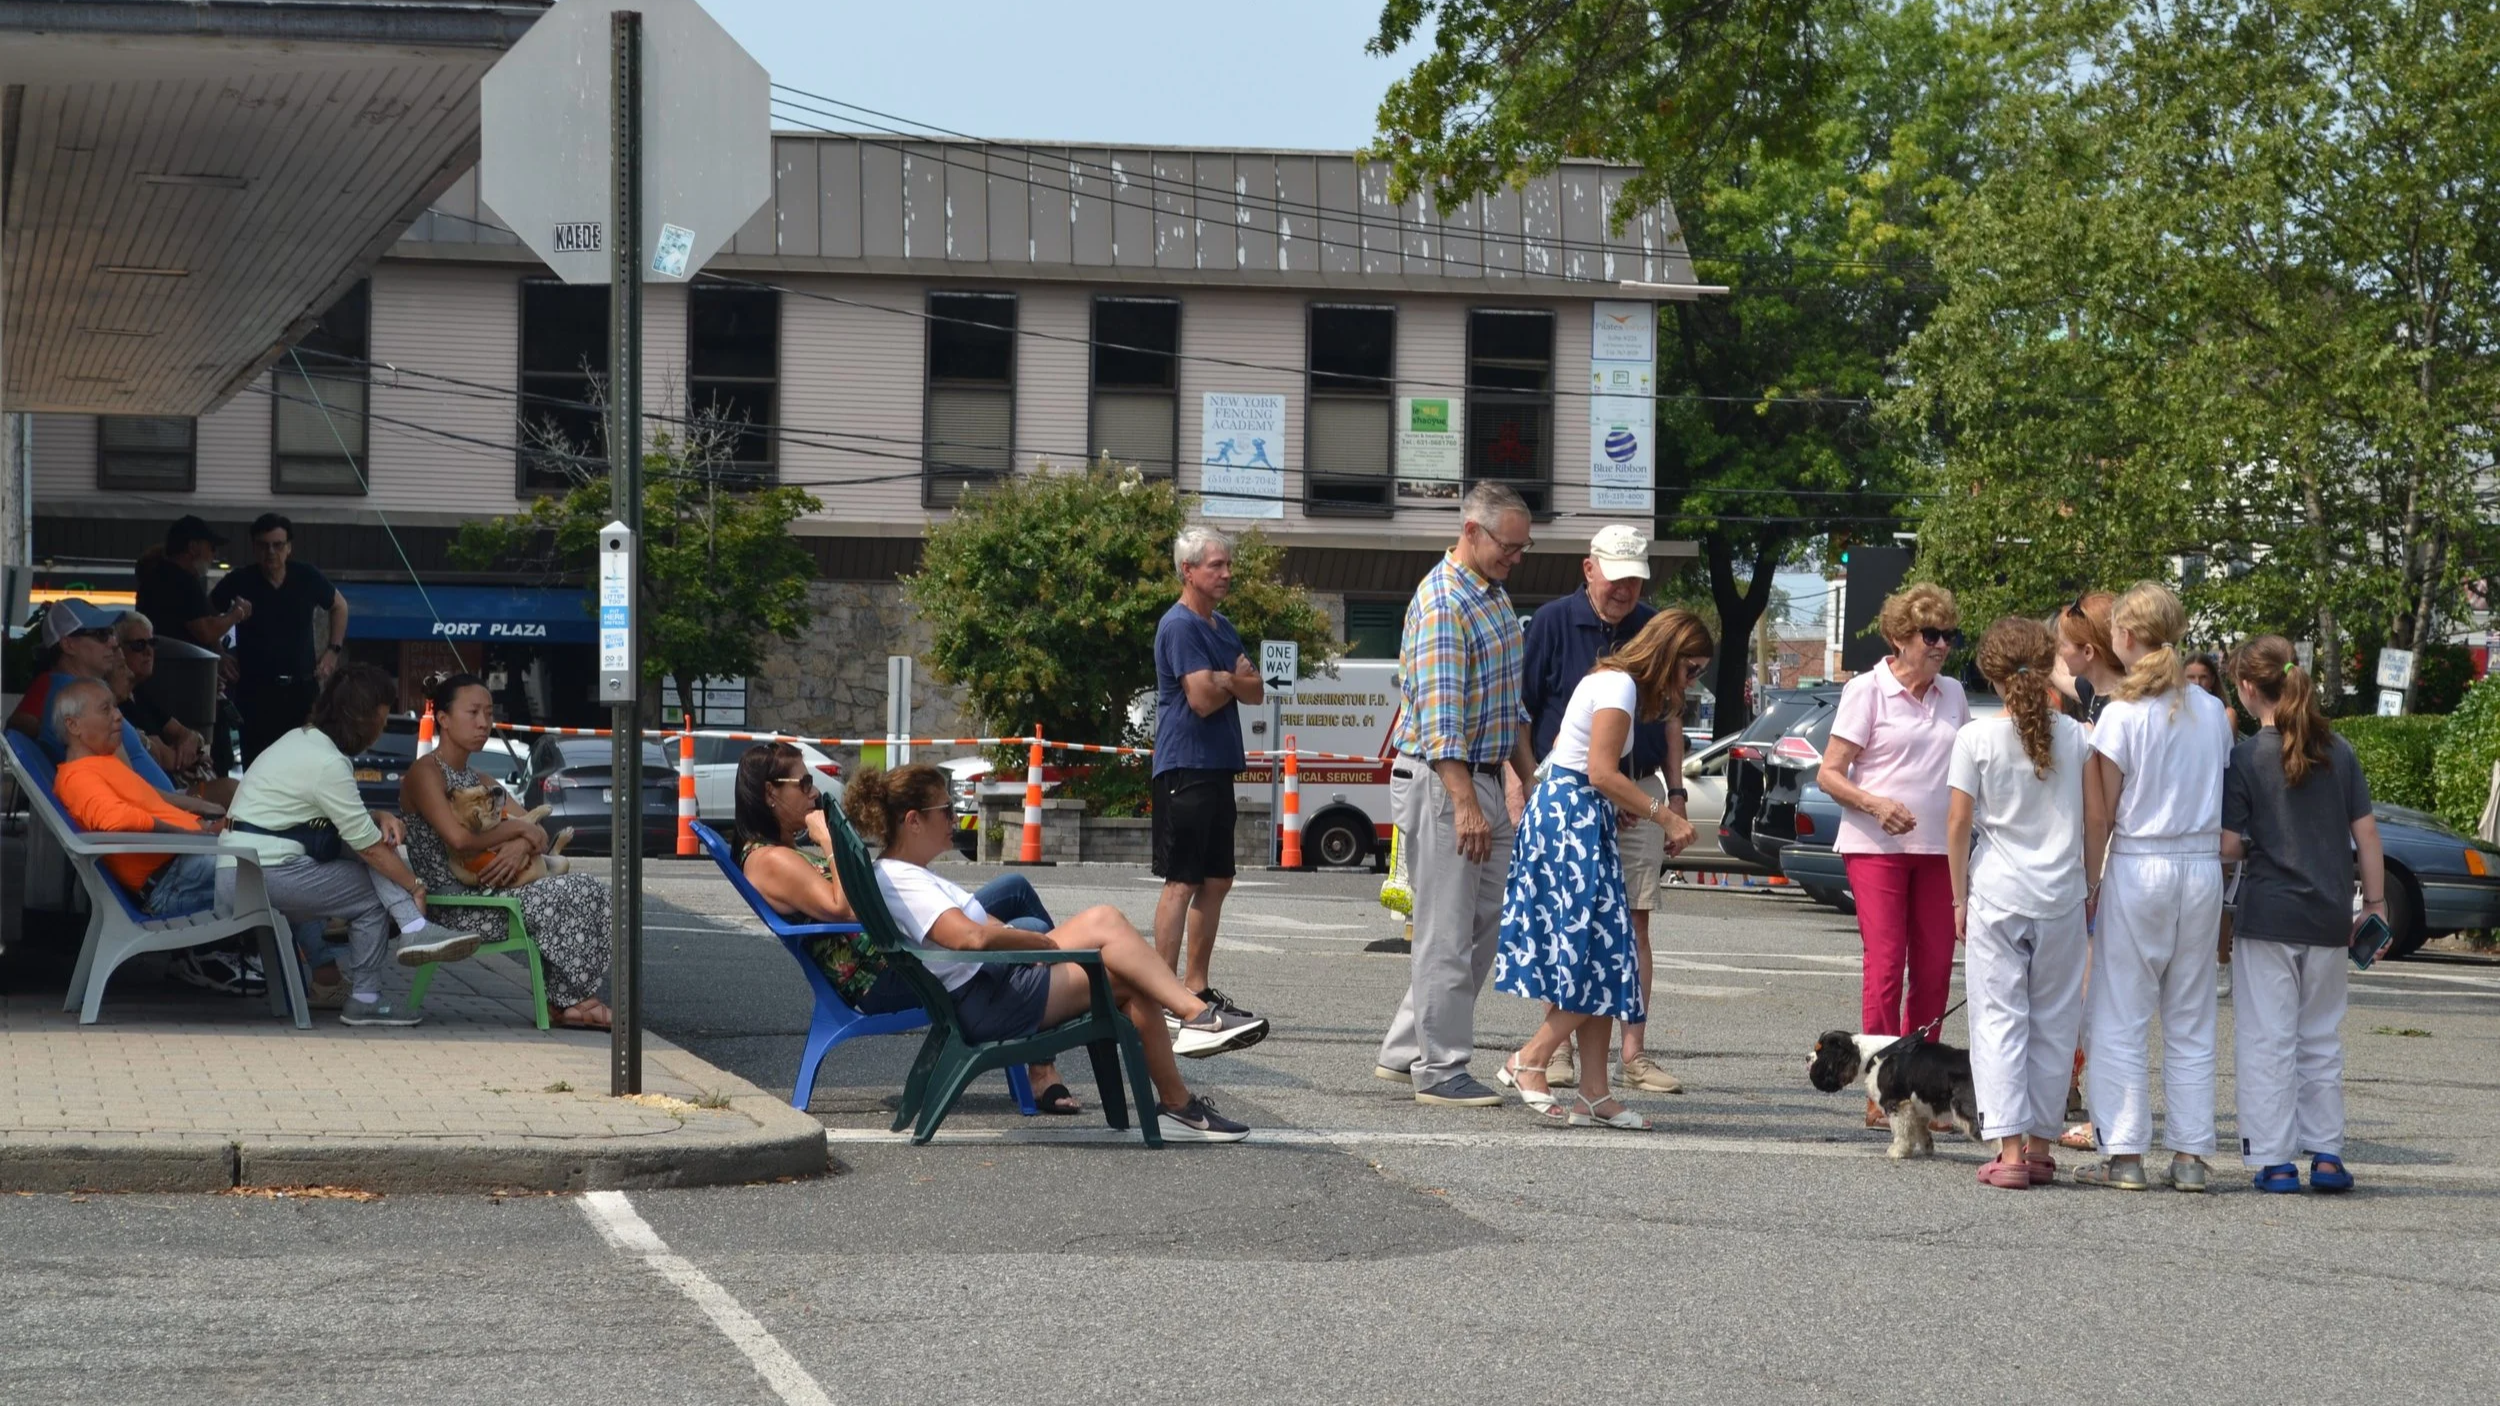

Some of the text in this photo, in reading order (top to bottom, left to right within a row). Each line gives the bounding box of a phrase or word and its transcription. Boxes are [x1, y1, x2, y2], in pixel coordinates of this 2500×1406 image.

[555, 224, 601, 250] KAEDE
[1595, 321, 1623, 331] Pilates
[1210, 396, 1278, 408] NEW YORK
[1215, 408, 1273, 419] FENCING
[1212, 419, 1275, 431] ACADEMY
[1412, 417, 1447, 426] shaoyue
[1593, 463, 1647, 474] Blue Ribbon
[432, 622, 546, 636] PORT PLAZA
[1266, 645, 1291, 659] ONE
[1266, 661, 1291, 674] WAY
[1297, 693, 1366, 706] WASHINGTON
[1369, 694, 1389, 706] F.D.
[1280, 714, 1375, 727] FIRE MEDIC CO. #1
[1234, 772, 1373, 782] GENCY MICAL SERVICE
